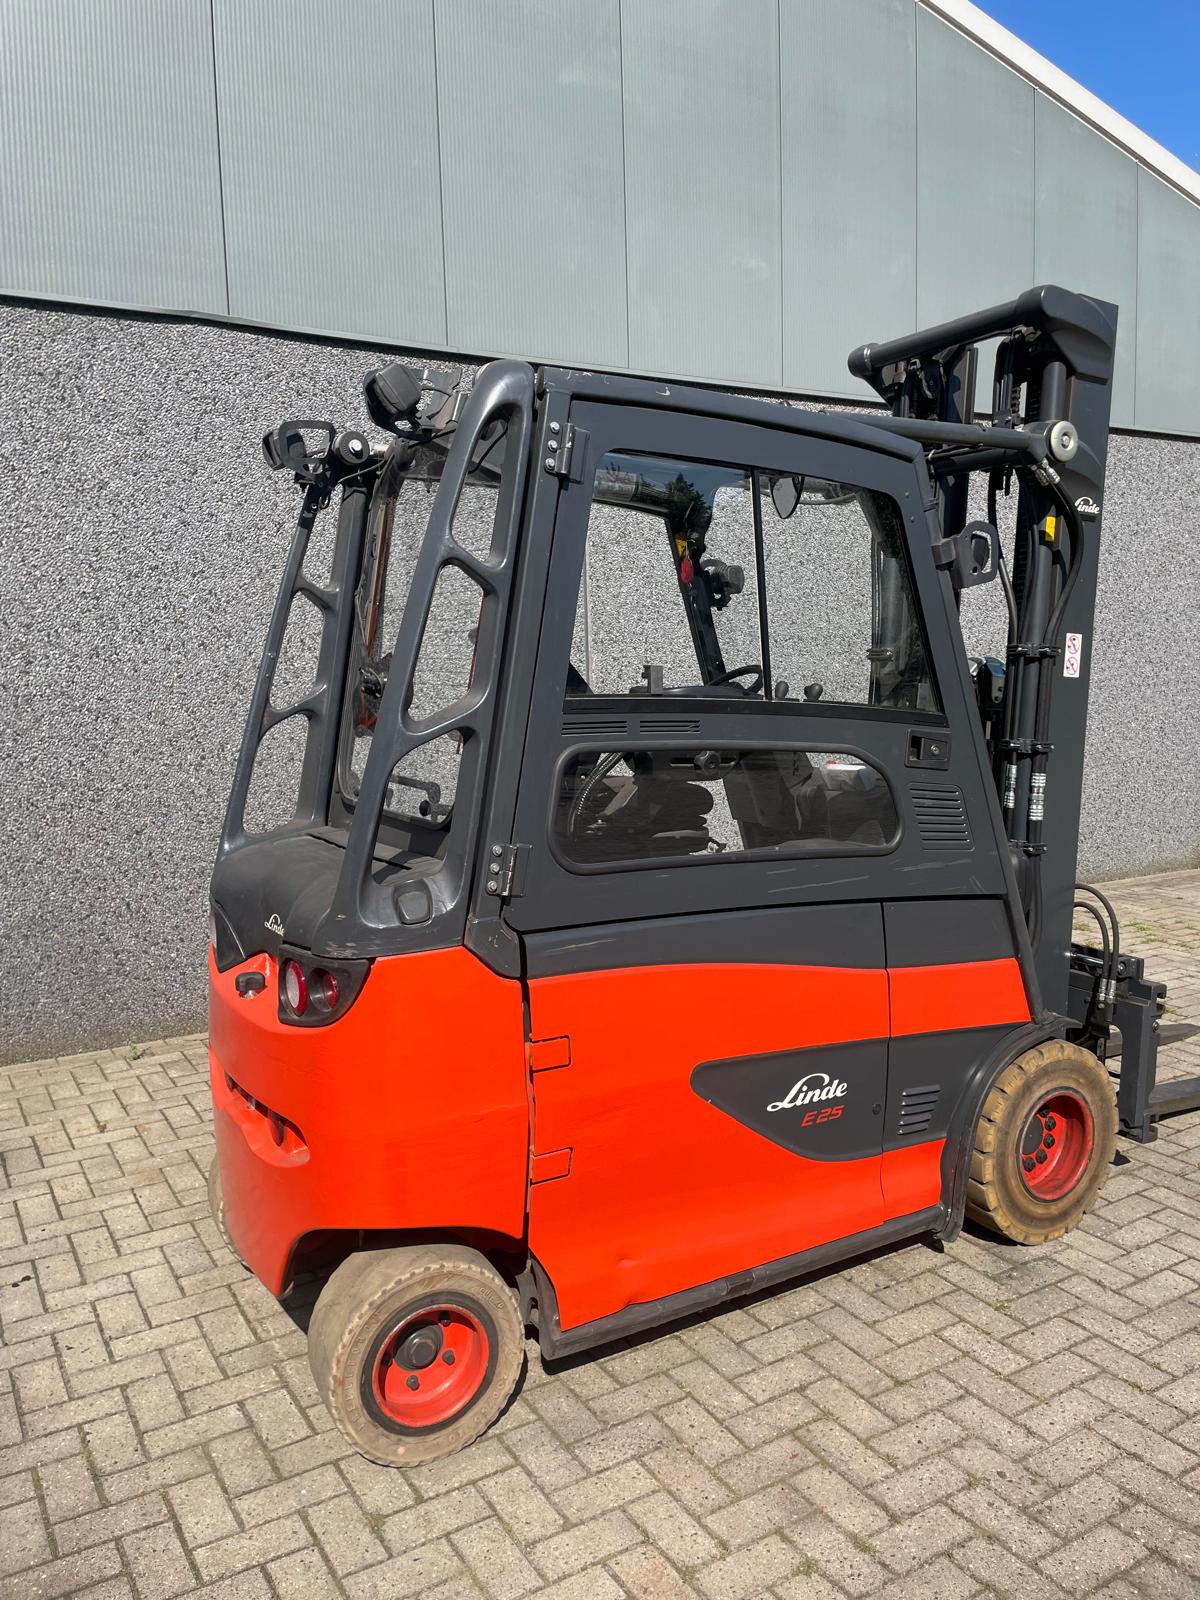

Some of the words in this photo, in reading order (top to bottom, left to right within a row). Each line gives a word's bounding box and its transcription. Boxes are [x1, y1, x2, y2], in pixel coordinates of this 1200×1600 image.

[264, 913, 285, 937] Linde
[766, 1072, 848, 1112] Linde
[801, 1105, 845, 1127] E25
